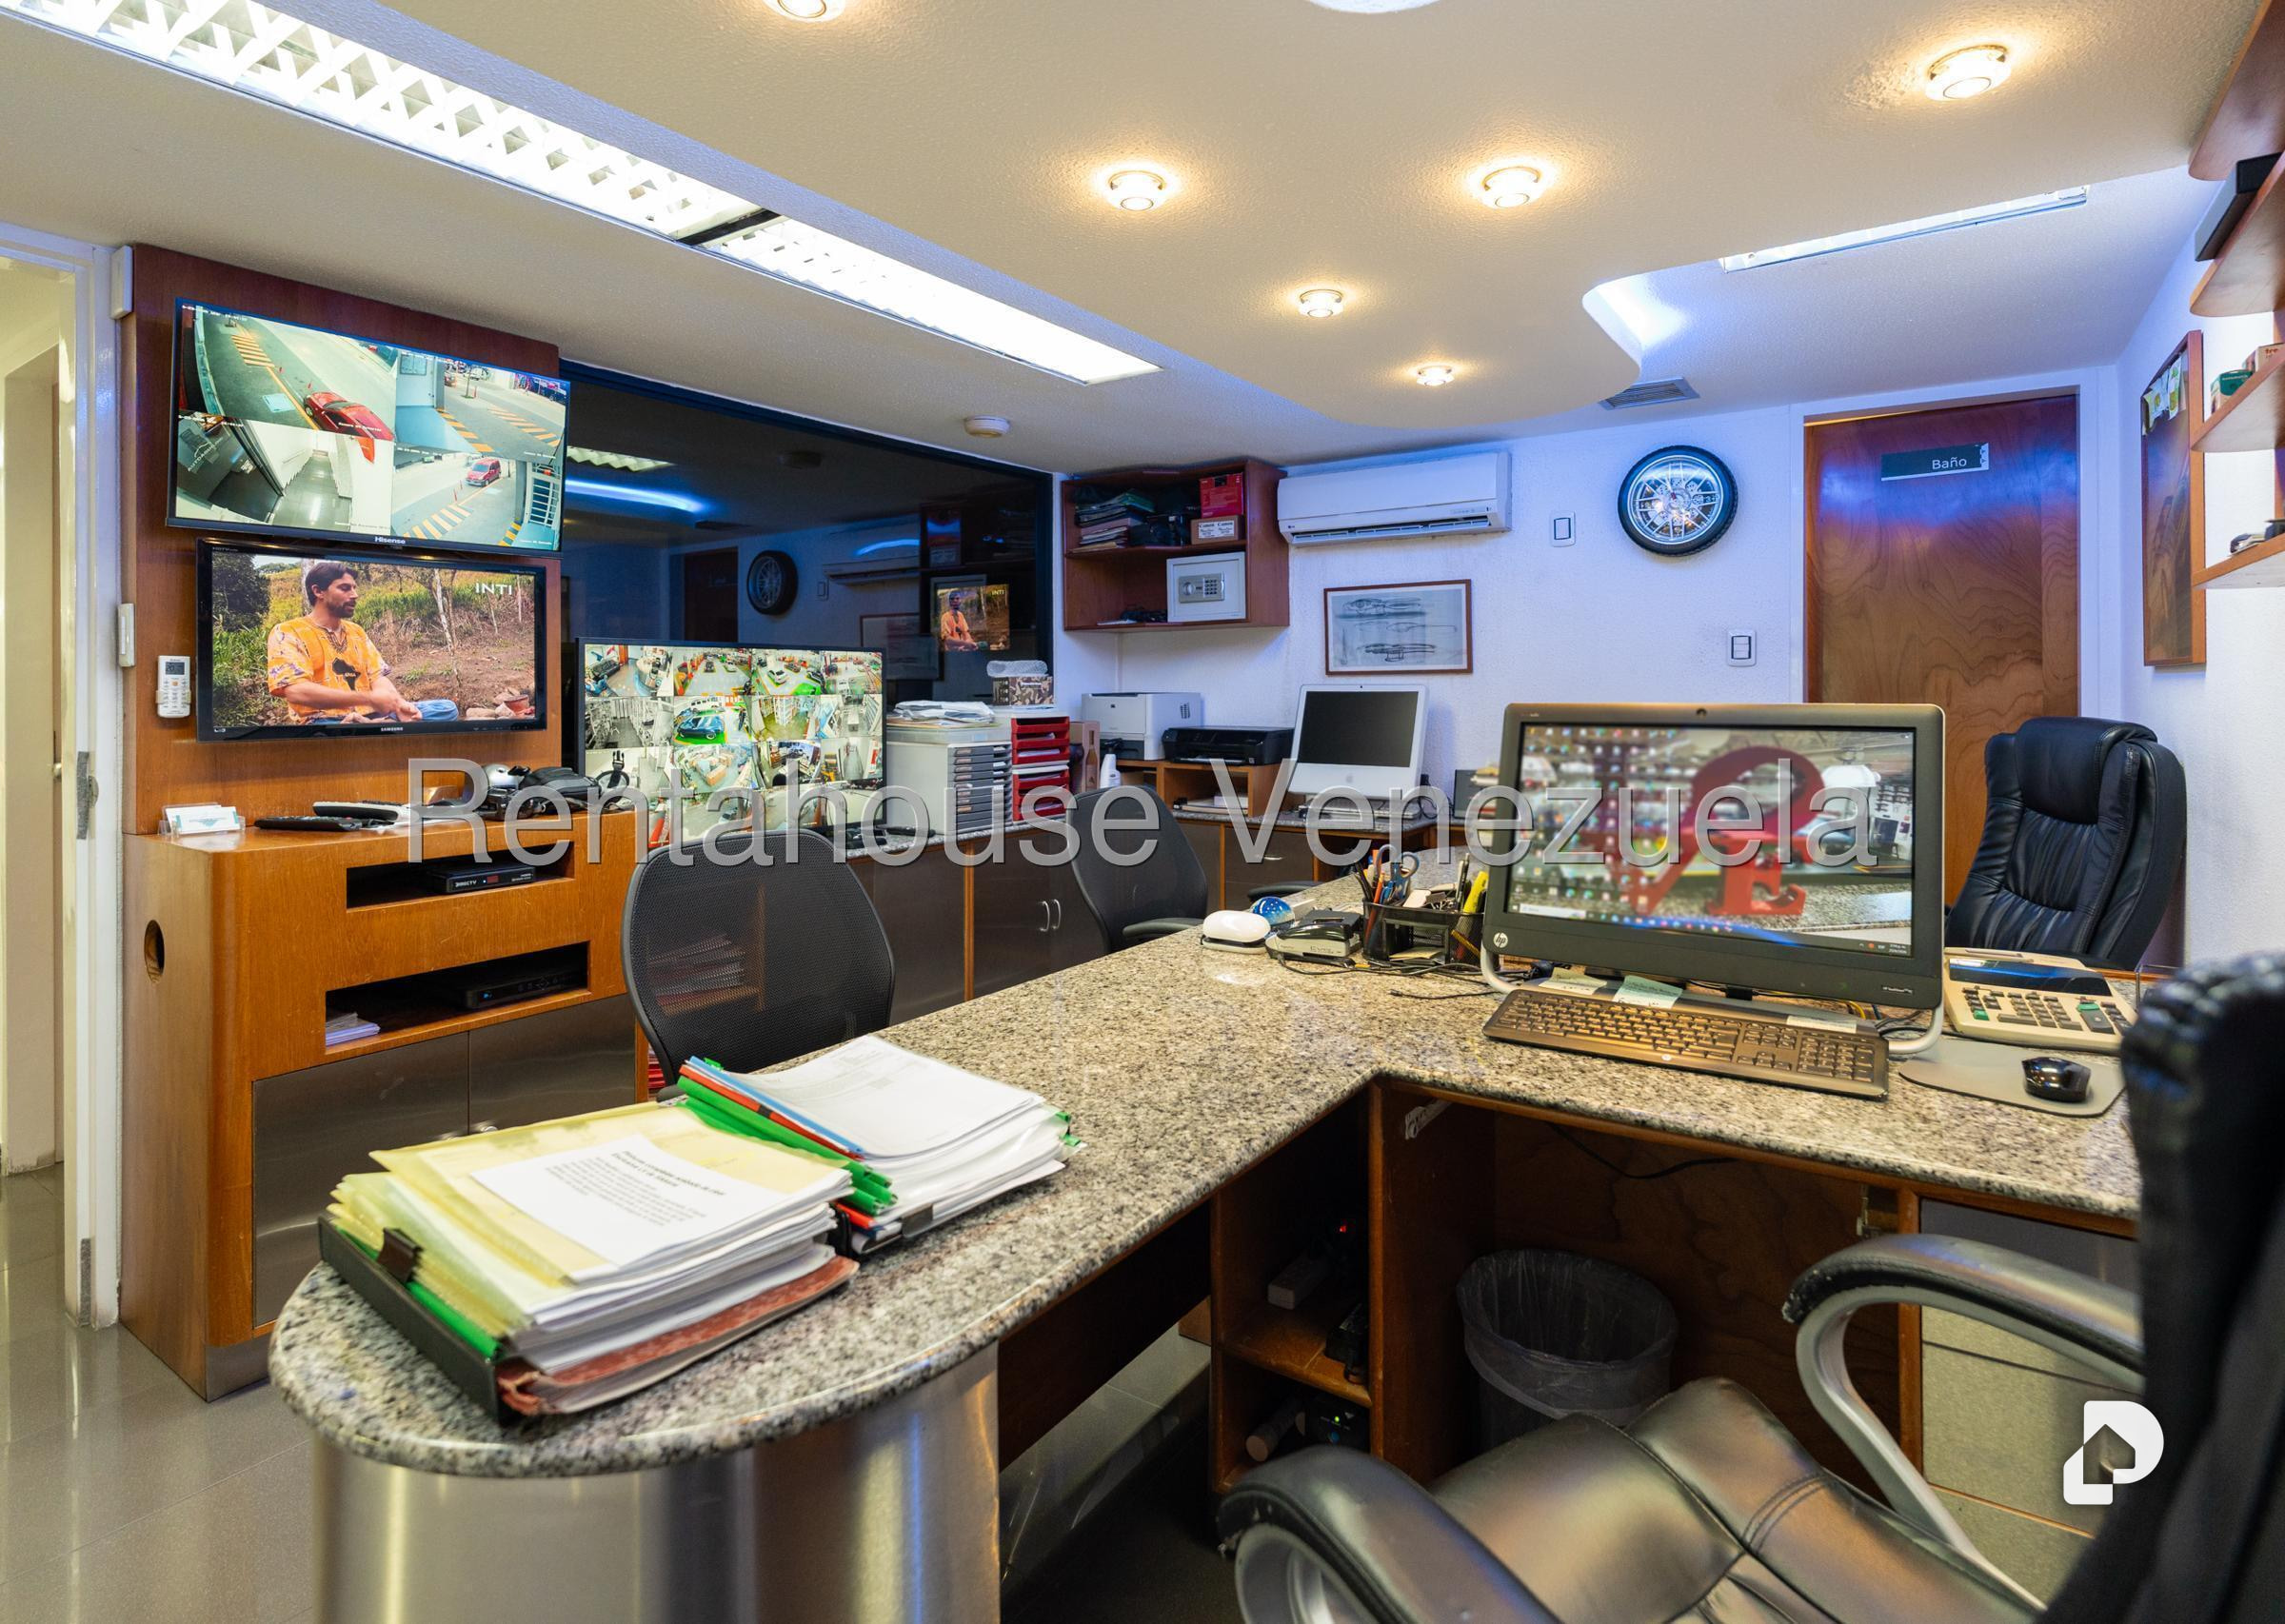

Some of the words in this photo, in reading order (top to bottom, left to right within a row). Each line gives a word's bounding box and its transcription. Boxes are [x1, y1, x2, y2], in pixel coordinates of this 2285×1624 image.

[1932, 457, 1968, 470] Baño
[374, 536, 407, 545] Hisense
[475, 582, 512, 595] INTI
[1495, 932, 1507, 948] hp
